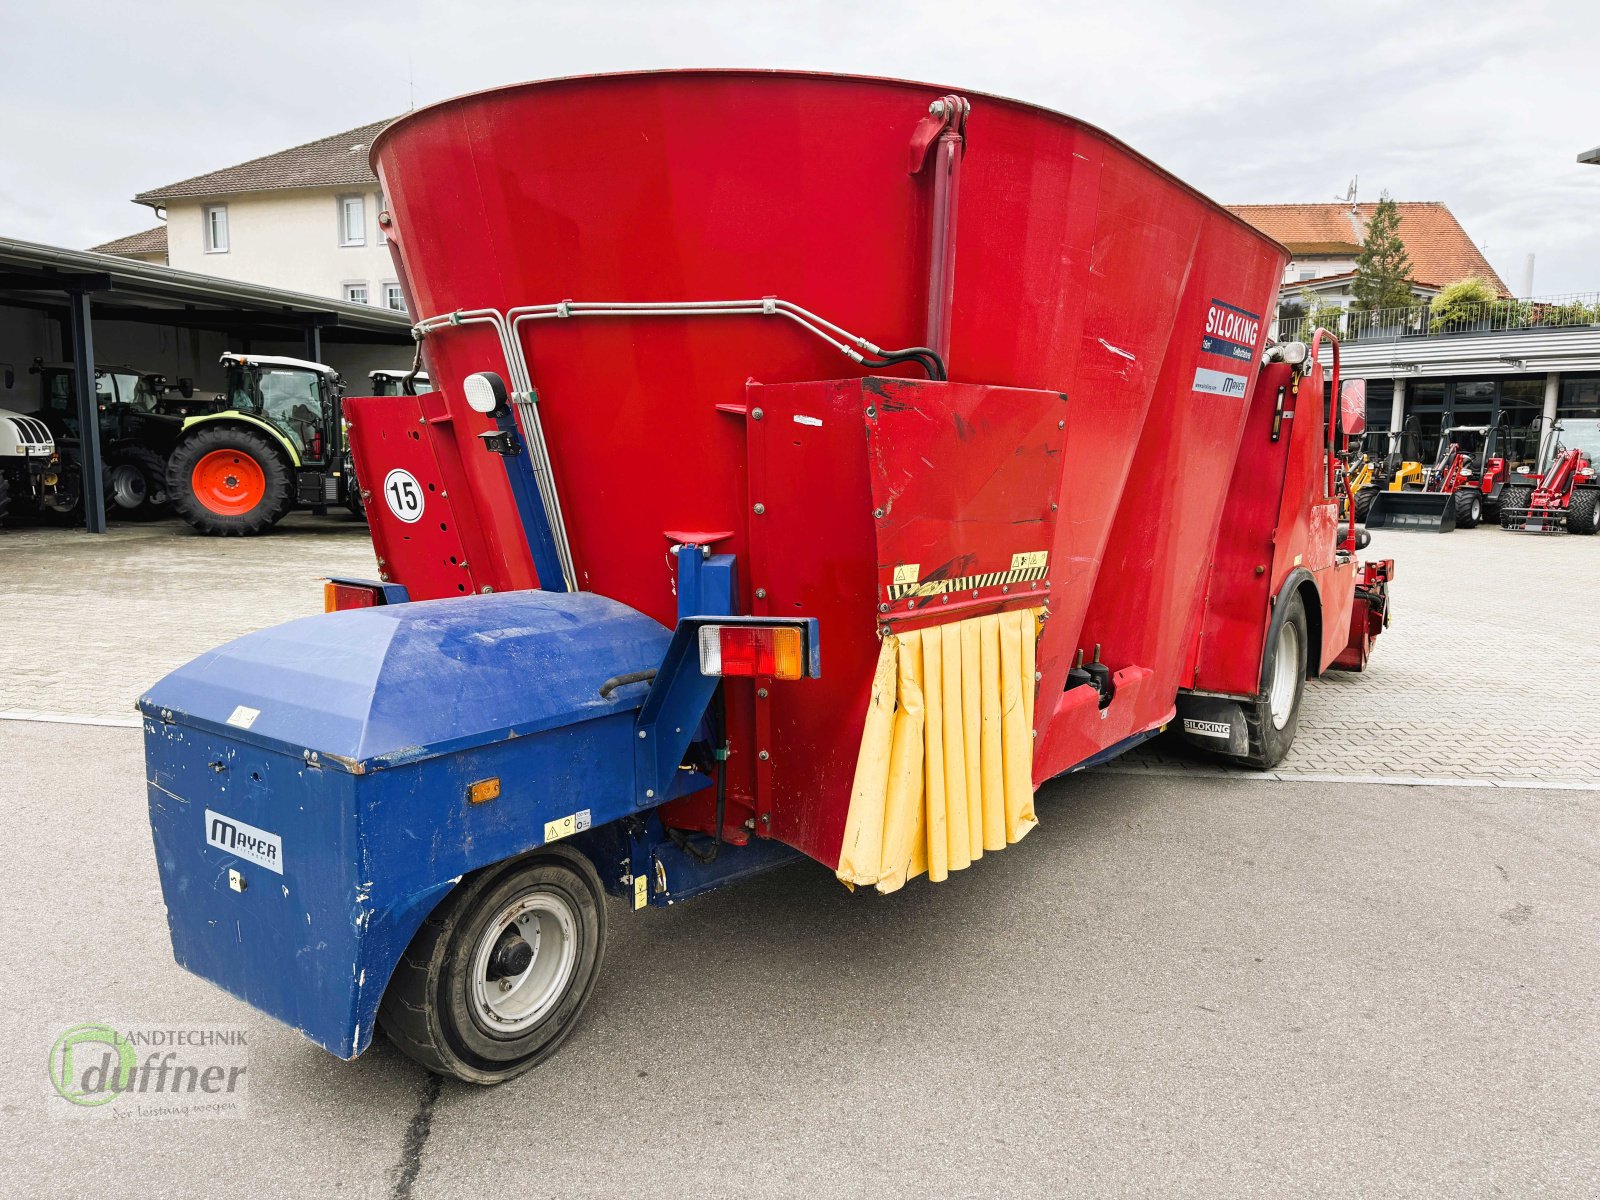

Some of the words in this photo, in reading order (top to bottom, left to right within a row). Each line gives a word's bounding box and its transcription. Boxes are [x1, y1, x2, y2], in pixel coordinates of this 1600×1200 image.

[1206, 307, 1258, 345] SILOKING
[390, 481, 418, 511] 15
[1184, 720, 1230, 733] SILOKING
[211, 818, 277, 860] MAYER
